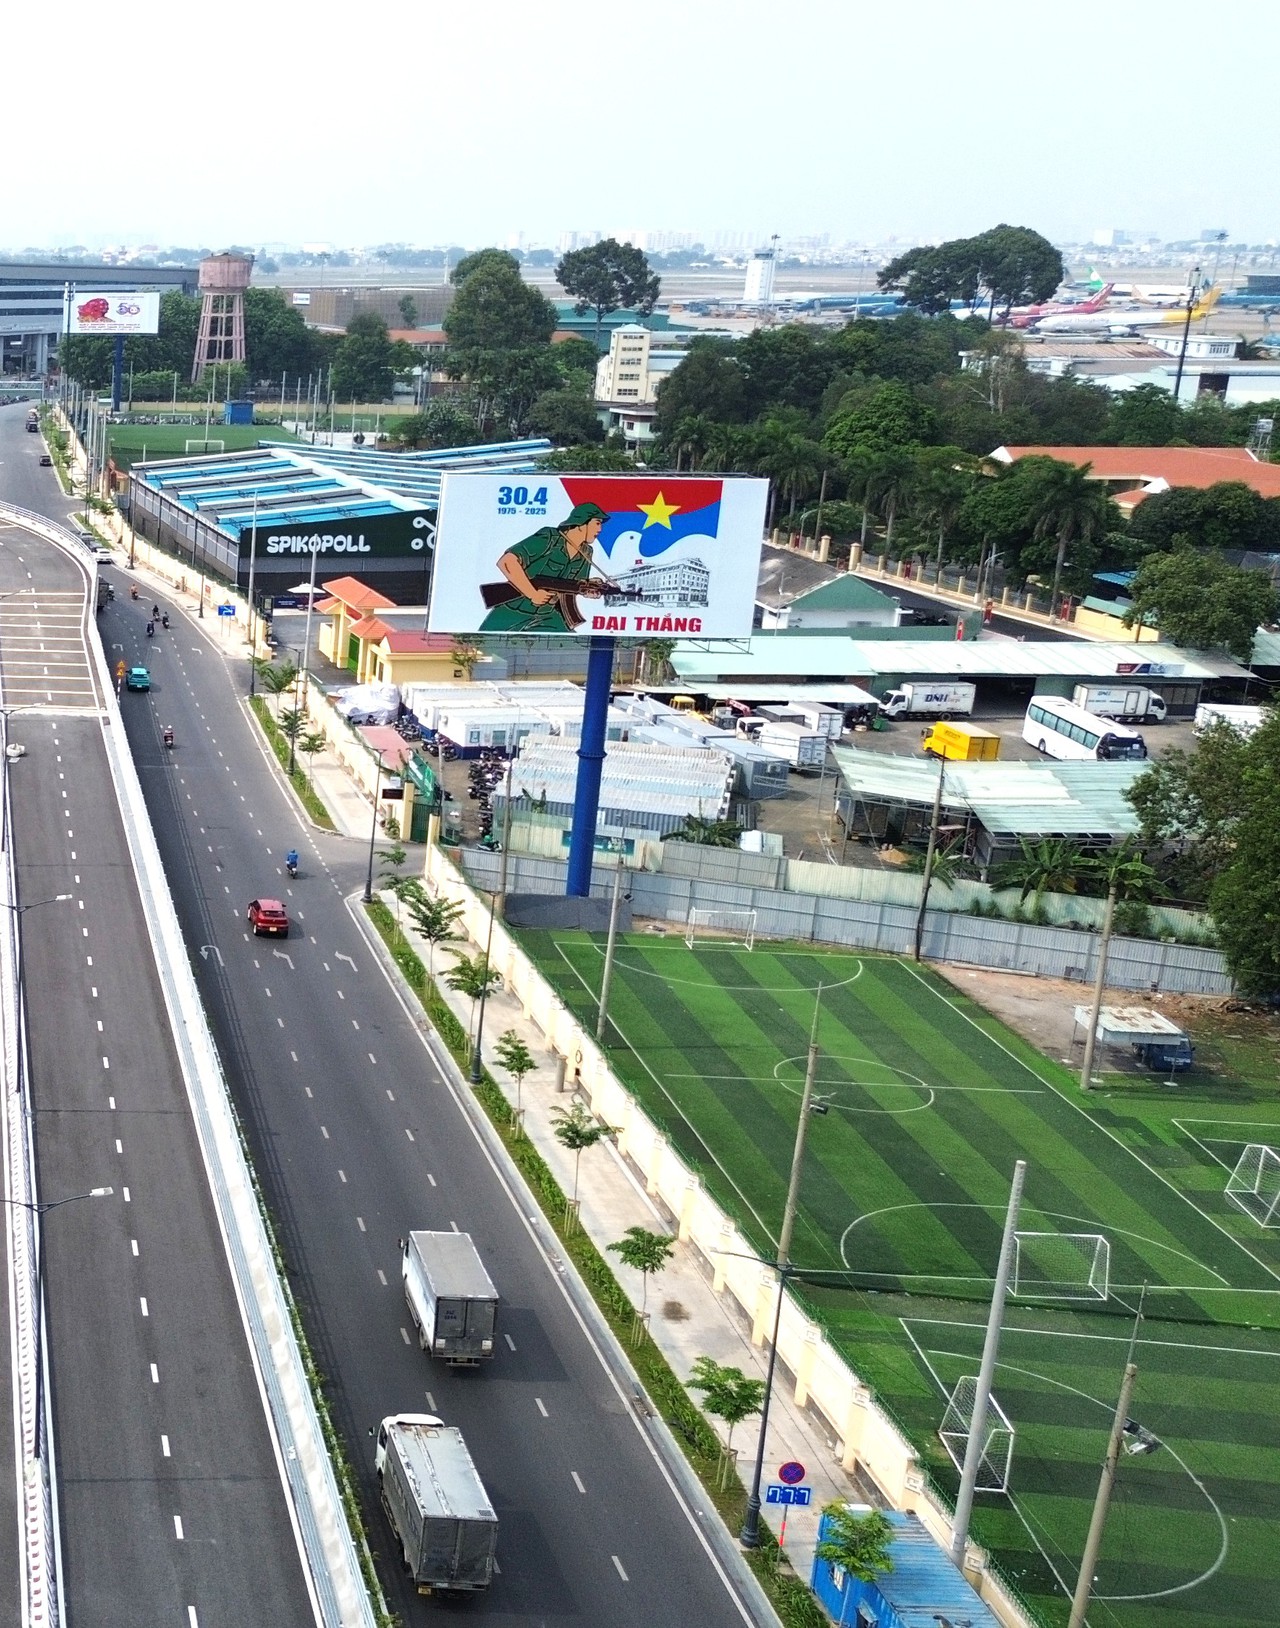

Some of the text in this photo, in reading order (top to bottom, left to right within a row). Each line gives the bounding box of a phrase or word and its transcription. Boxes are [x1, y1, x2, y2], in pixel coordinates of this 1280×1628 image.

[498, 486, 548, 505] 30.4
[497, 507, 517, 515] 1975
[524, 507, 547, 515] 2025
[266, 535, 371, 553] SPIKOPOLL
[591, 613, 702, 633] ĐẠI THẮNG
